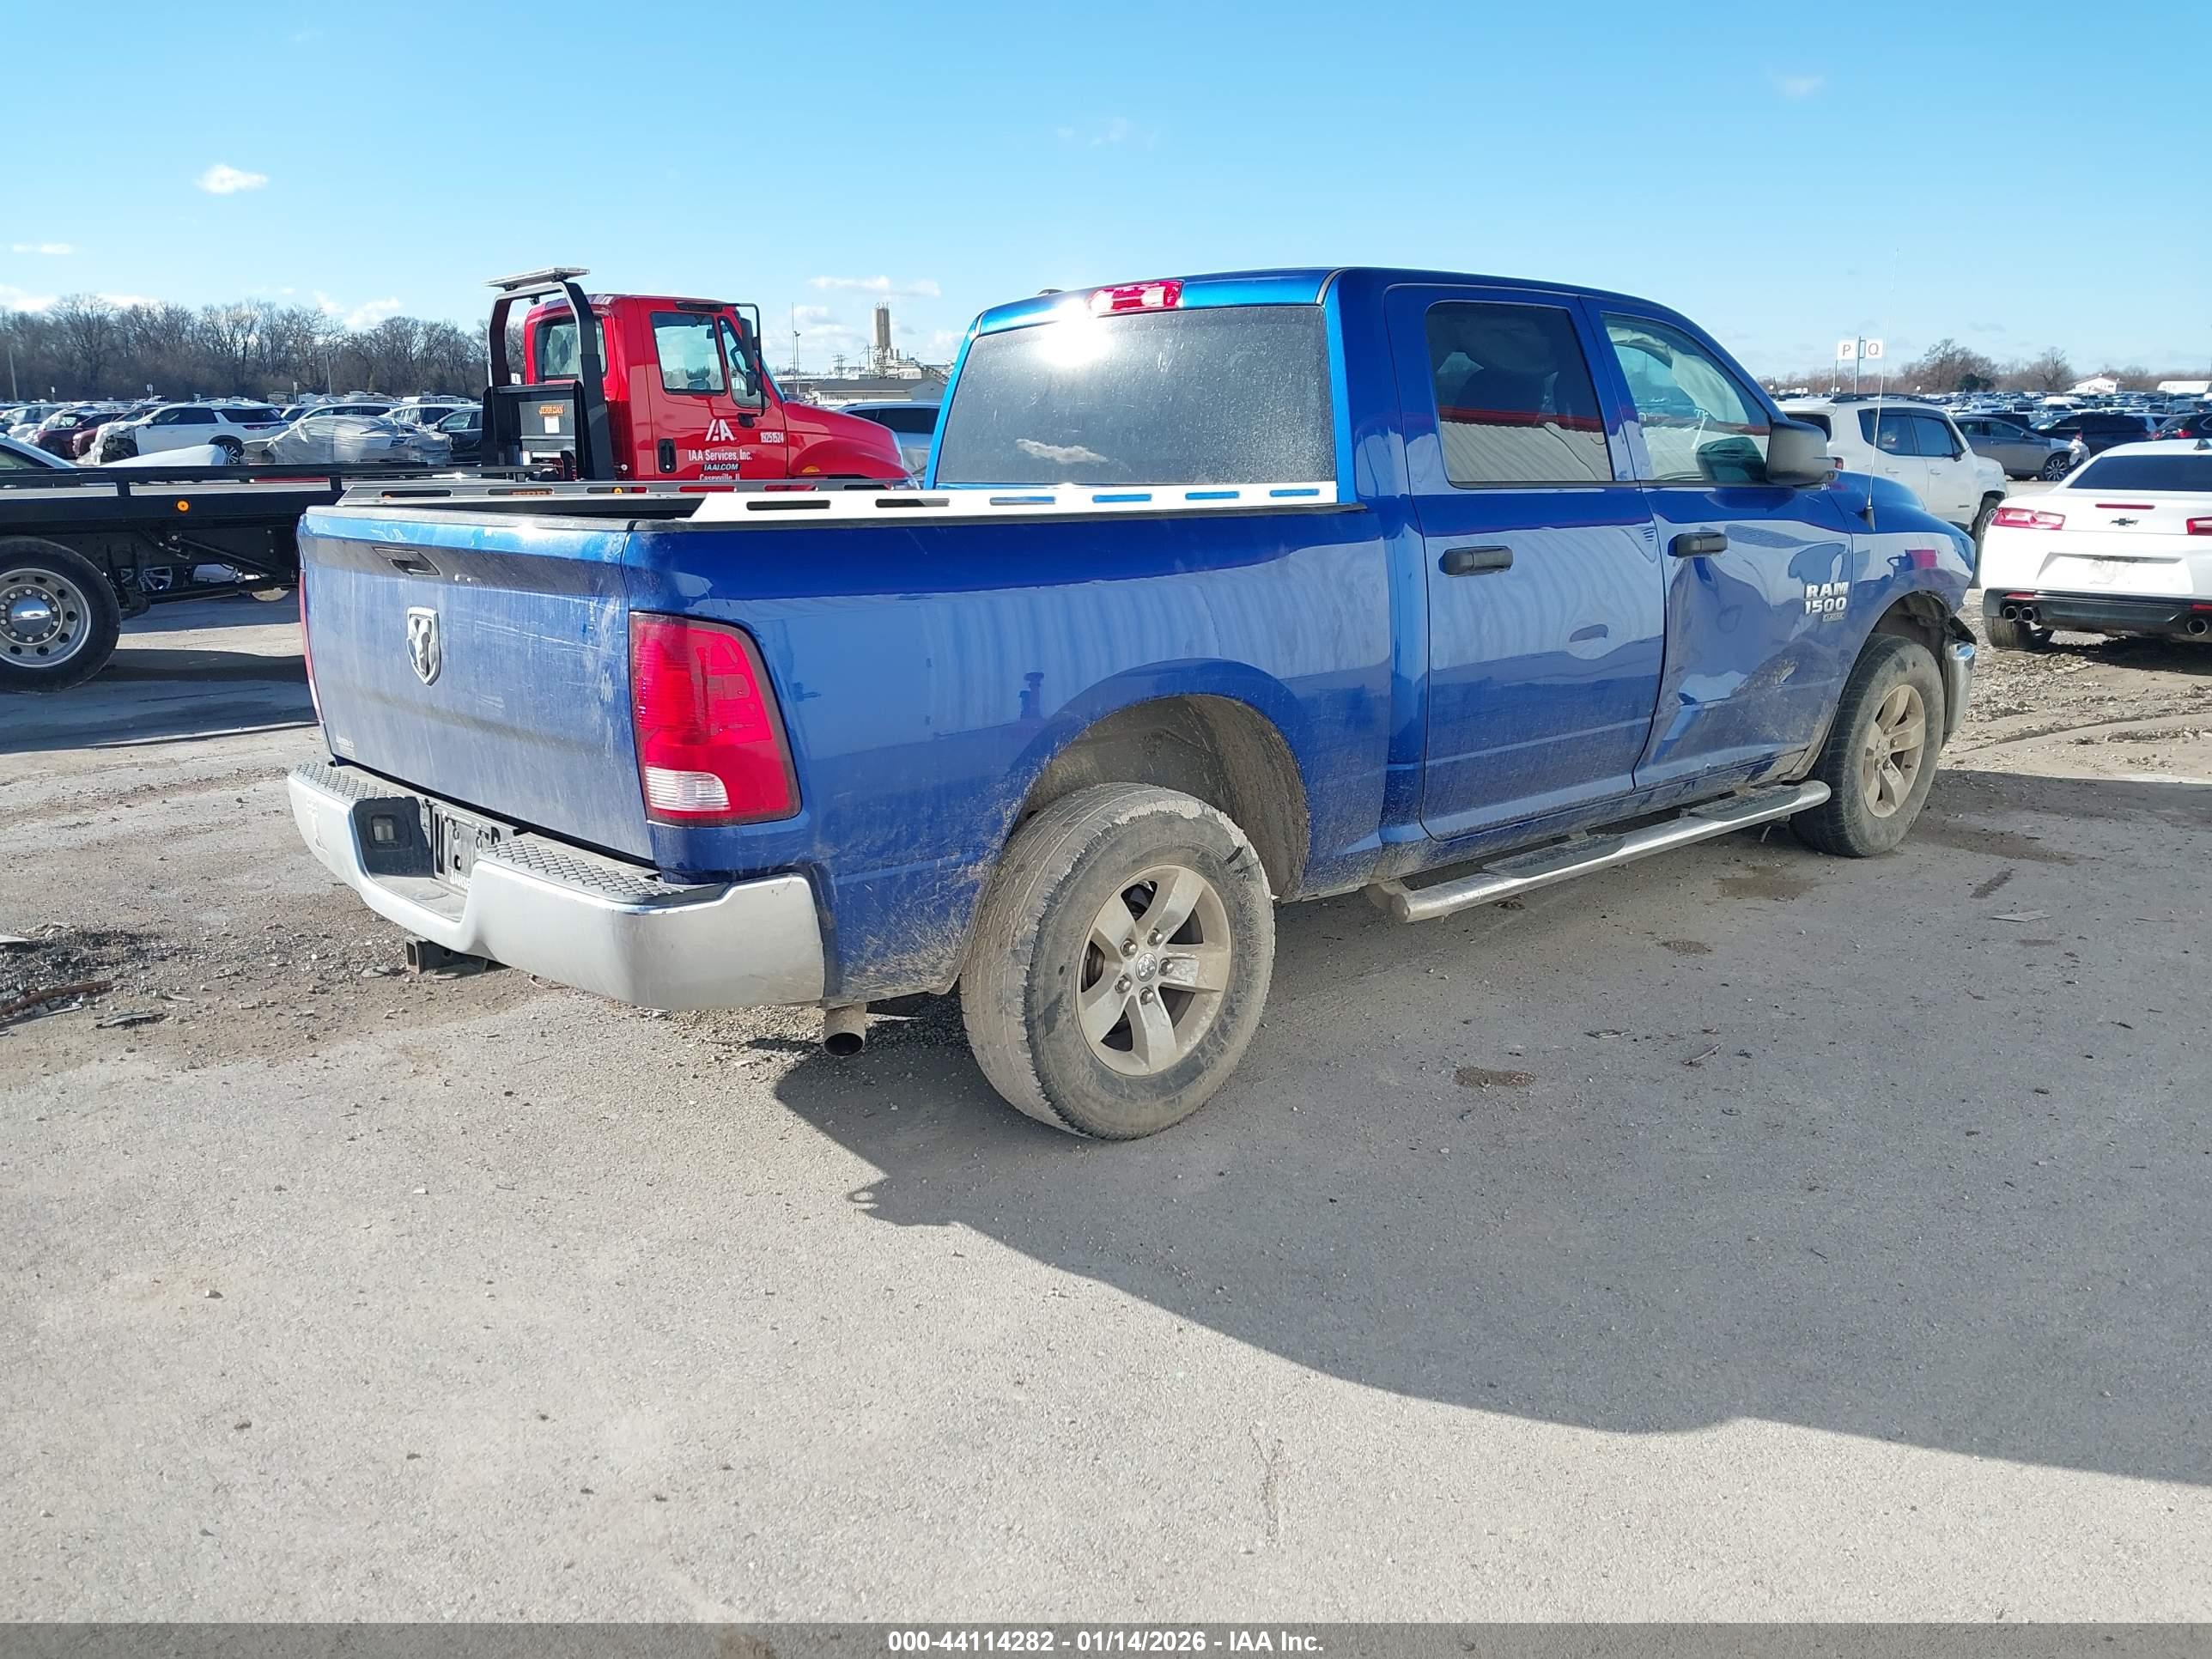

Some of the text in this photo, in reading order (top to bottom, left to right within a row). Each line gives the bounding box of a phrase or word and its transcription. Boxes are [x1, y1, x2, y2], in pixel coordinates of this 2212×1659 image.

[1843, 344, 1851, 356] P
[1868, 343, 1879, 356] Q
[688, 449, 704, 461] IAA
[739, 448, 753, 461] Inc.
[704, 463, 739, 471] IAAI.COM
[1806, 581, 1849, 599] RAM
[1805, 597, 1847, 616] 1500
